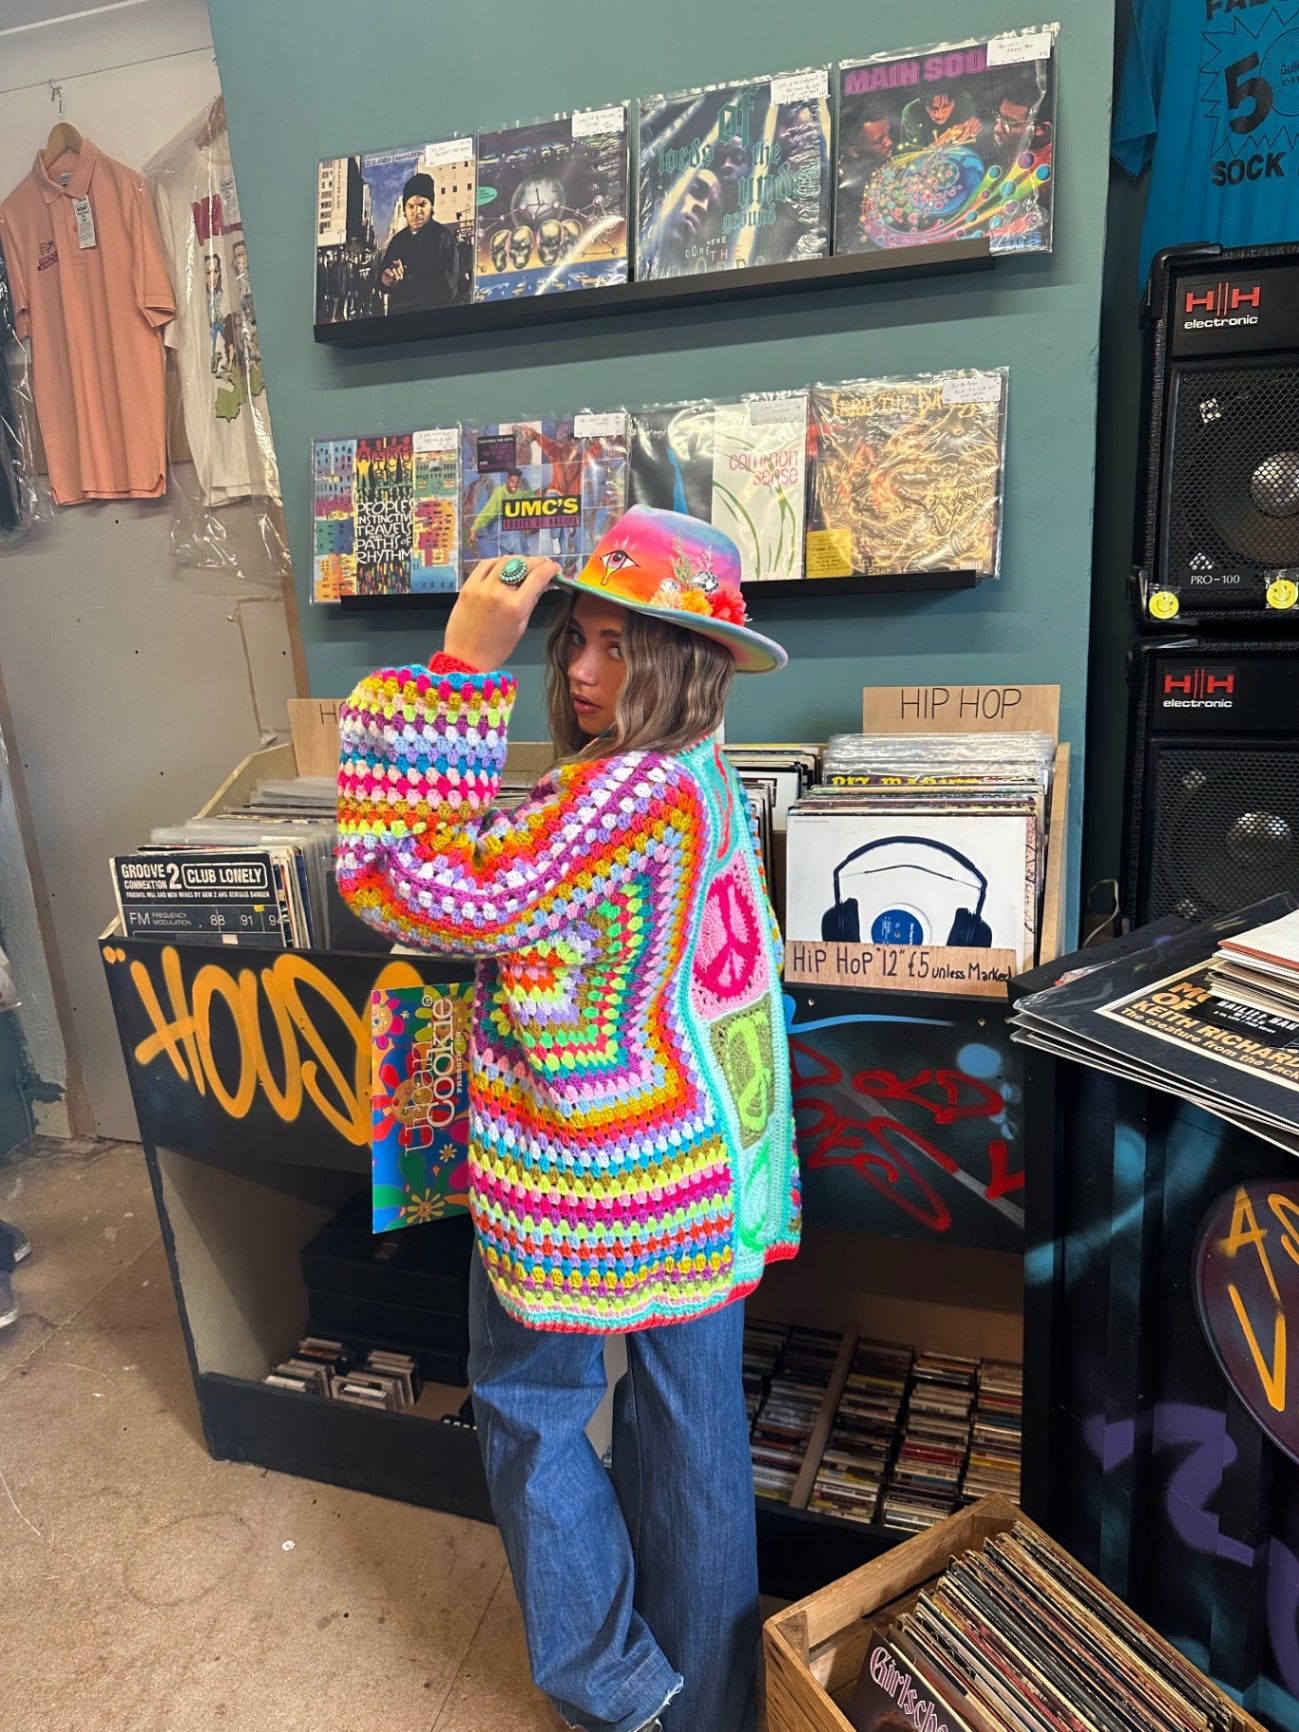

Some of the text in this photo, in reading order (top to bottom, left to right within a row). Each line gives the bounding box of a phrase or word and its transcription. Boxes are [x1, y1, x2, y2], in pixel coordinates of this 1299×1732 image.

[844, 59, 920, 96] MAIN
[923, 49, 990, 82] SOU
[657, 137, 715, 175] lords
[753, 139, 782, 165] the
[1211, 152, 1286, 187] SOCK
[722, 203, 777, 234] ground
[1184, 314, 1258, 330] electronic
[729, 450, 798, 470] common
[753, 468, 798, 486] sense
[504, 498, 579, 518] UMC'S
[357, 522, 412, 536] TRAVELS
[535, 517, 544, 527] OF
[356, 548, 413, 564] RHYTHM
[357, 535, 401, 551] PATHS
[1190, 575, 1240, 584] PRO-100
[901, 687, 1022, 719] HIP HOP
[1163, 699, 1233, 709] electronic
[121, 863, 262, 889] GROOVE 2 CLUB LONELY
[130, 912, 150, 925] FM
[210, 914, 226, 926] 88
[240, 914, 253, 926] 91
[908, 950, 929, 979] £5
[932, 964, 966, 980] unless
[1132, 1000, 1199, 1028] KEITH
[1152, 992, 1199, 1011] OF
[1121, 1008, 1143, 1021] The
[1145, 1017, 1201, 1043] creature
[1202, 1040, 1237, 1057] from
[1239, 1053, 1264, 1066] the
[426, 998, 455, 1127] Cookie
[404, 1041, 434, 1157] Urban
[869, 1646, 949, 1732] Girlsch
